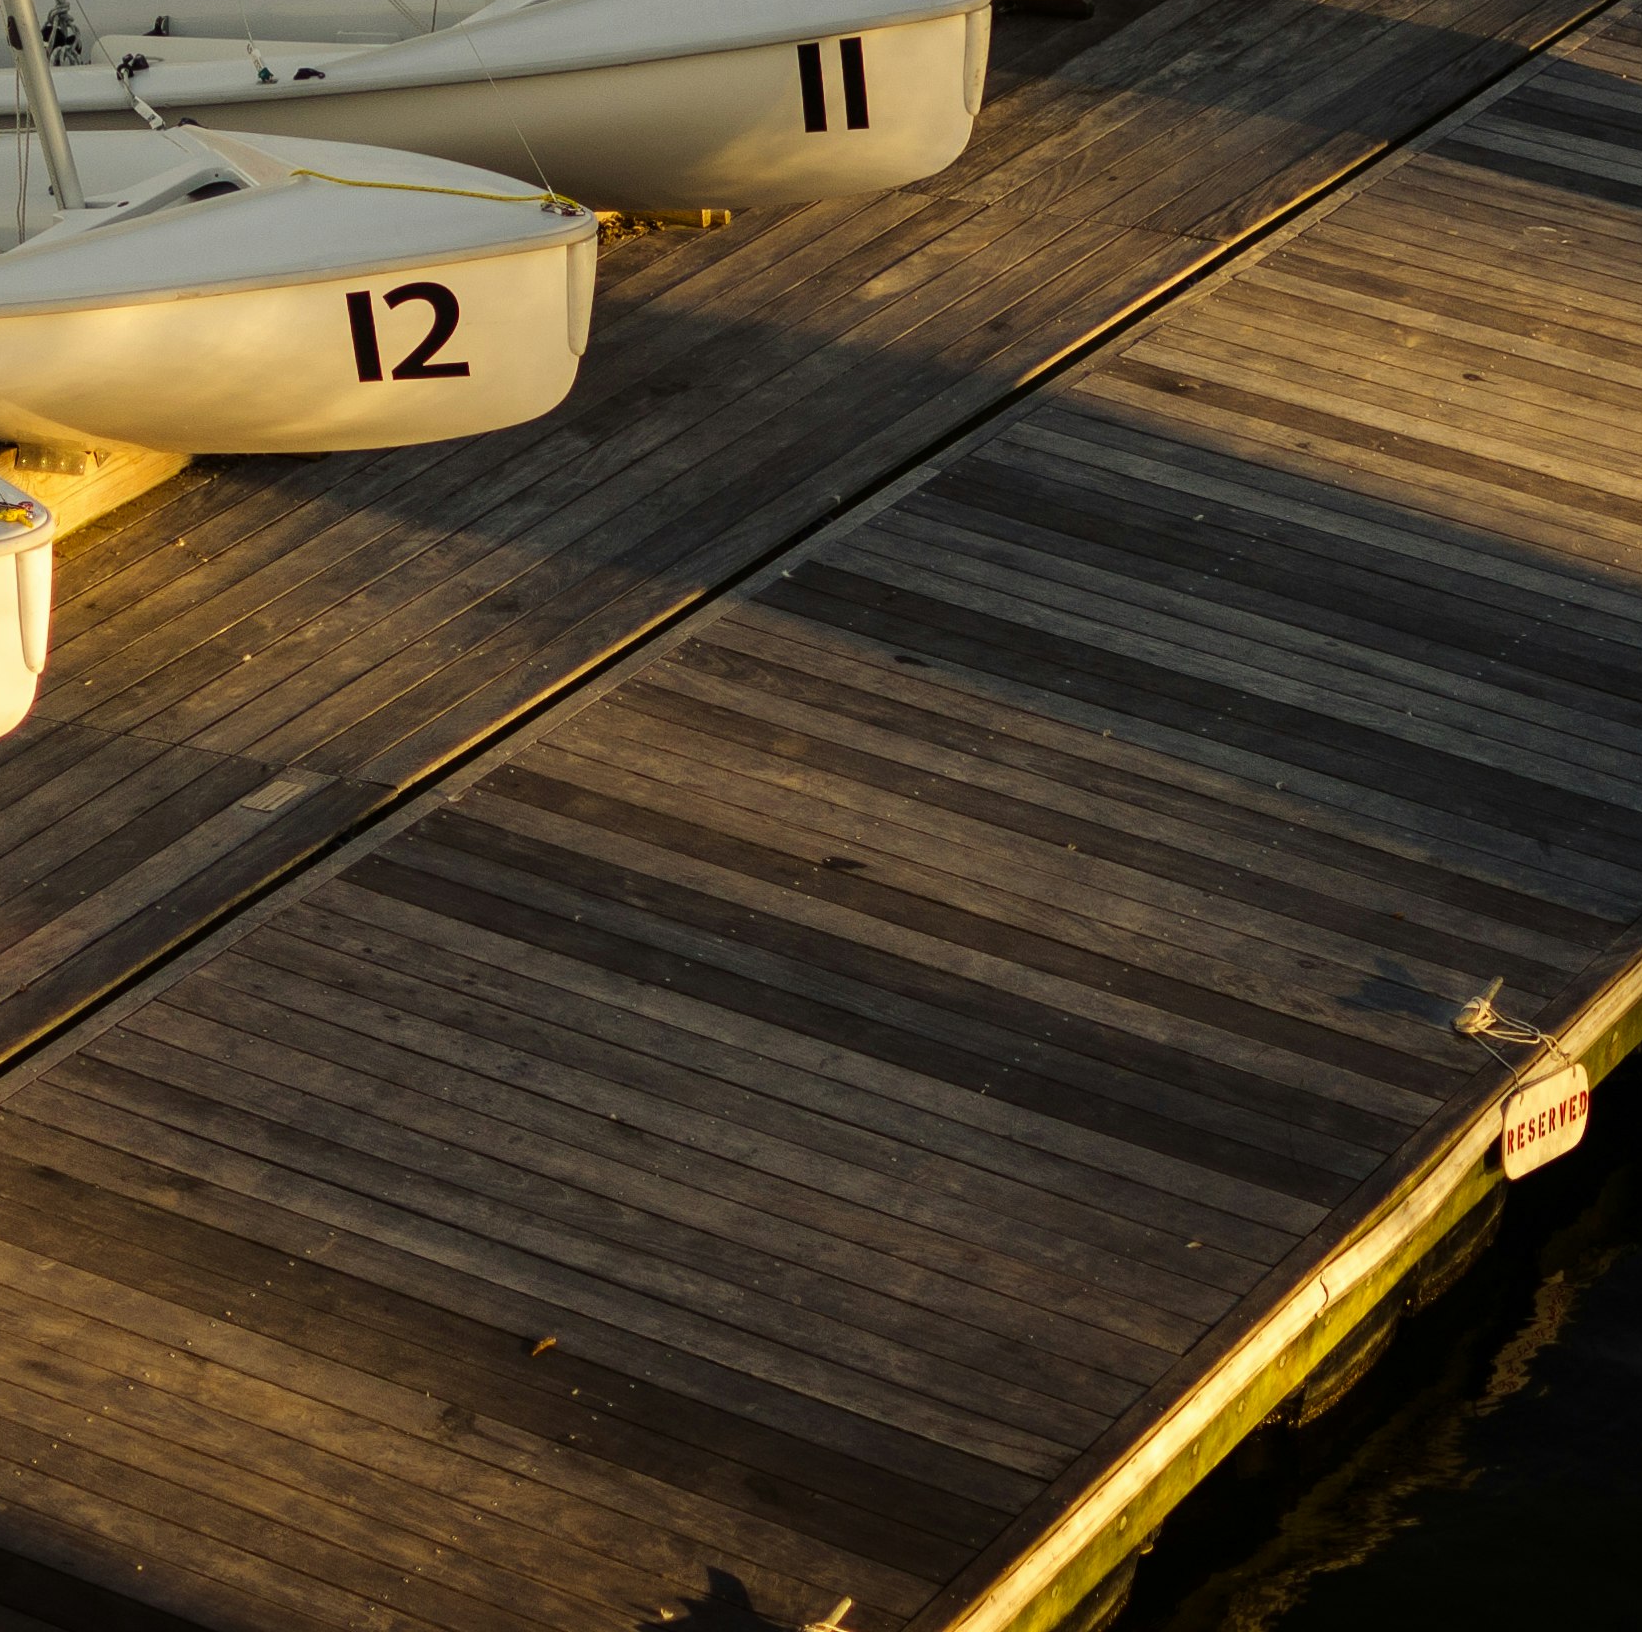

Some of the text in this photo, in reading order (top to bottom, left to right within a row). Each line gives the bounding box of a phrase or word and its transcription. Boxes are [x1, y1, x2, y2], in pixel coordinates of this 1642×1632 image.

[796, 36, 870, 133] 11
[345, 281, 471, 383] 12
[1506, 1089, 1589, 1157] RESERVED
